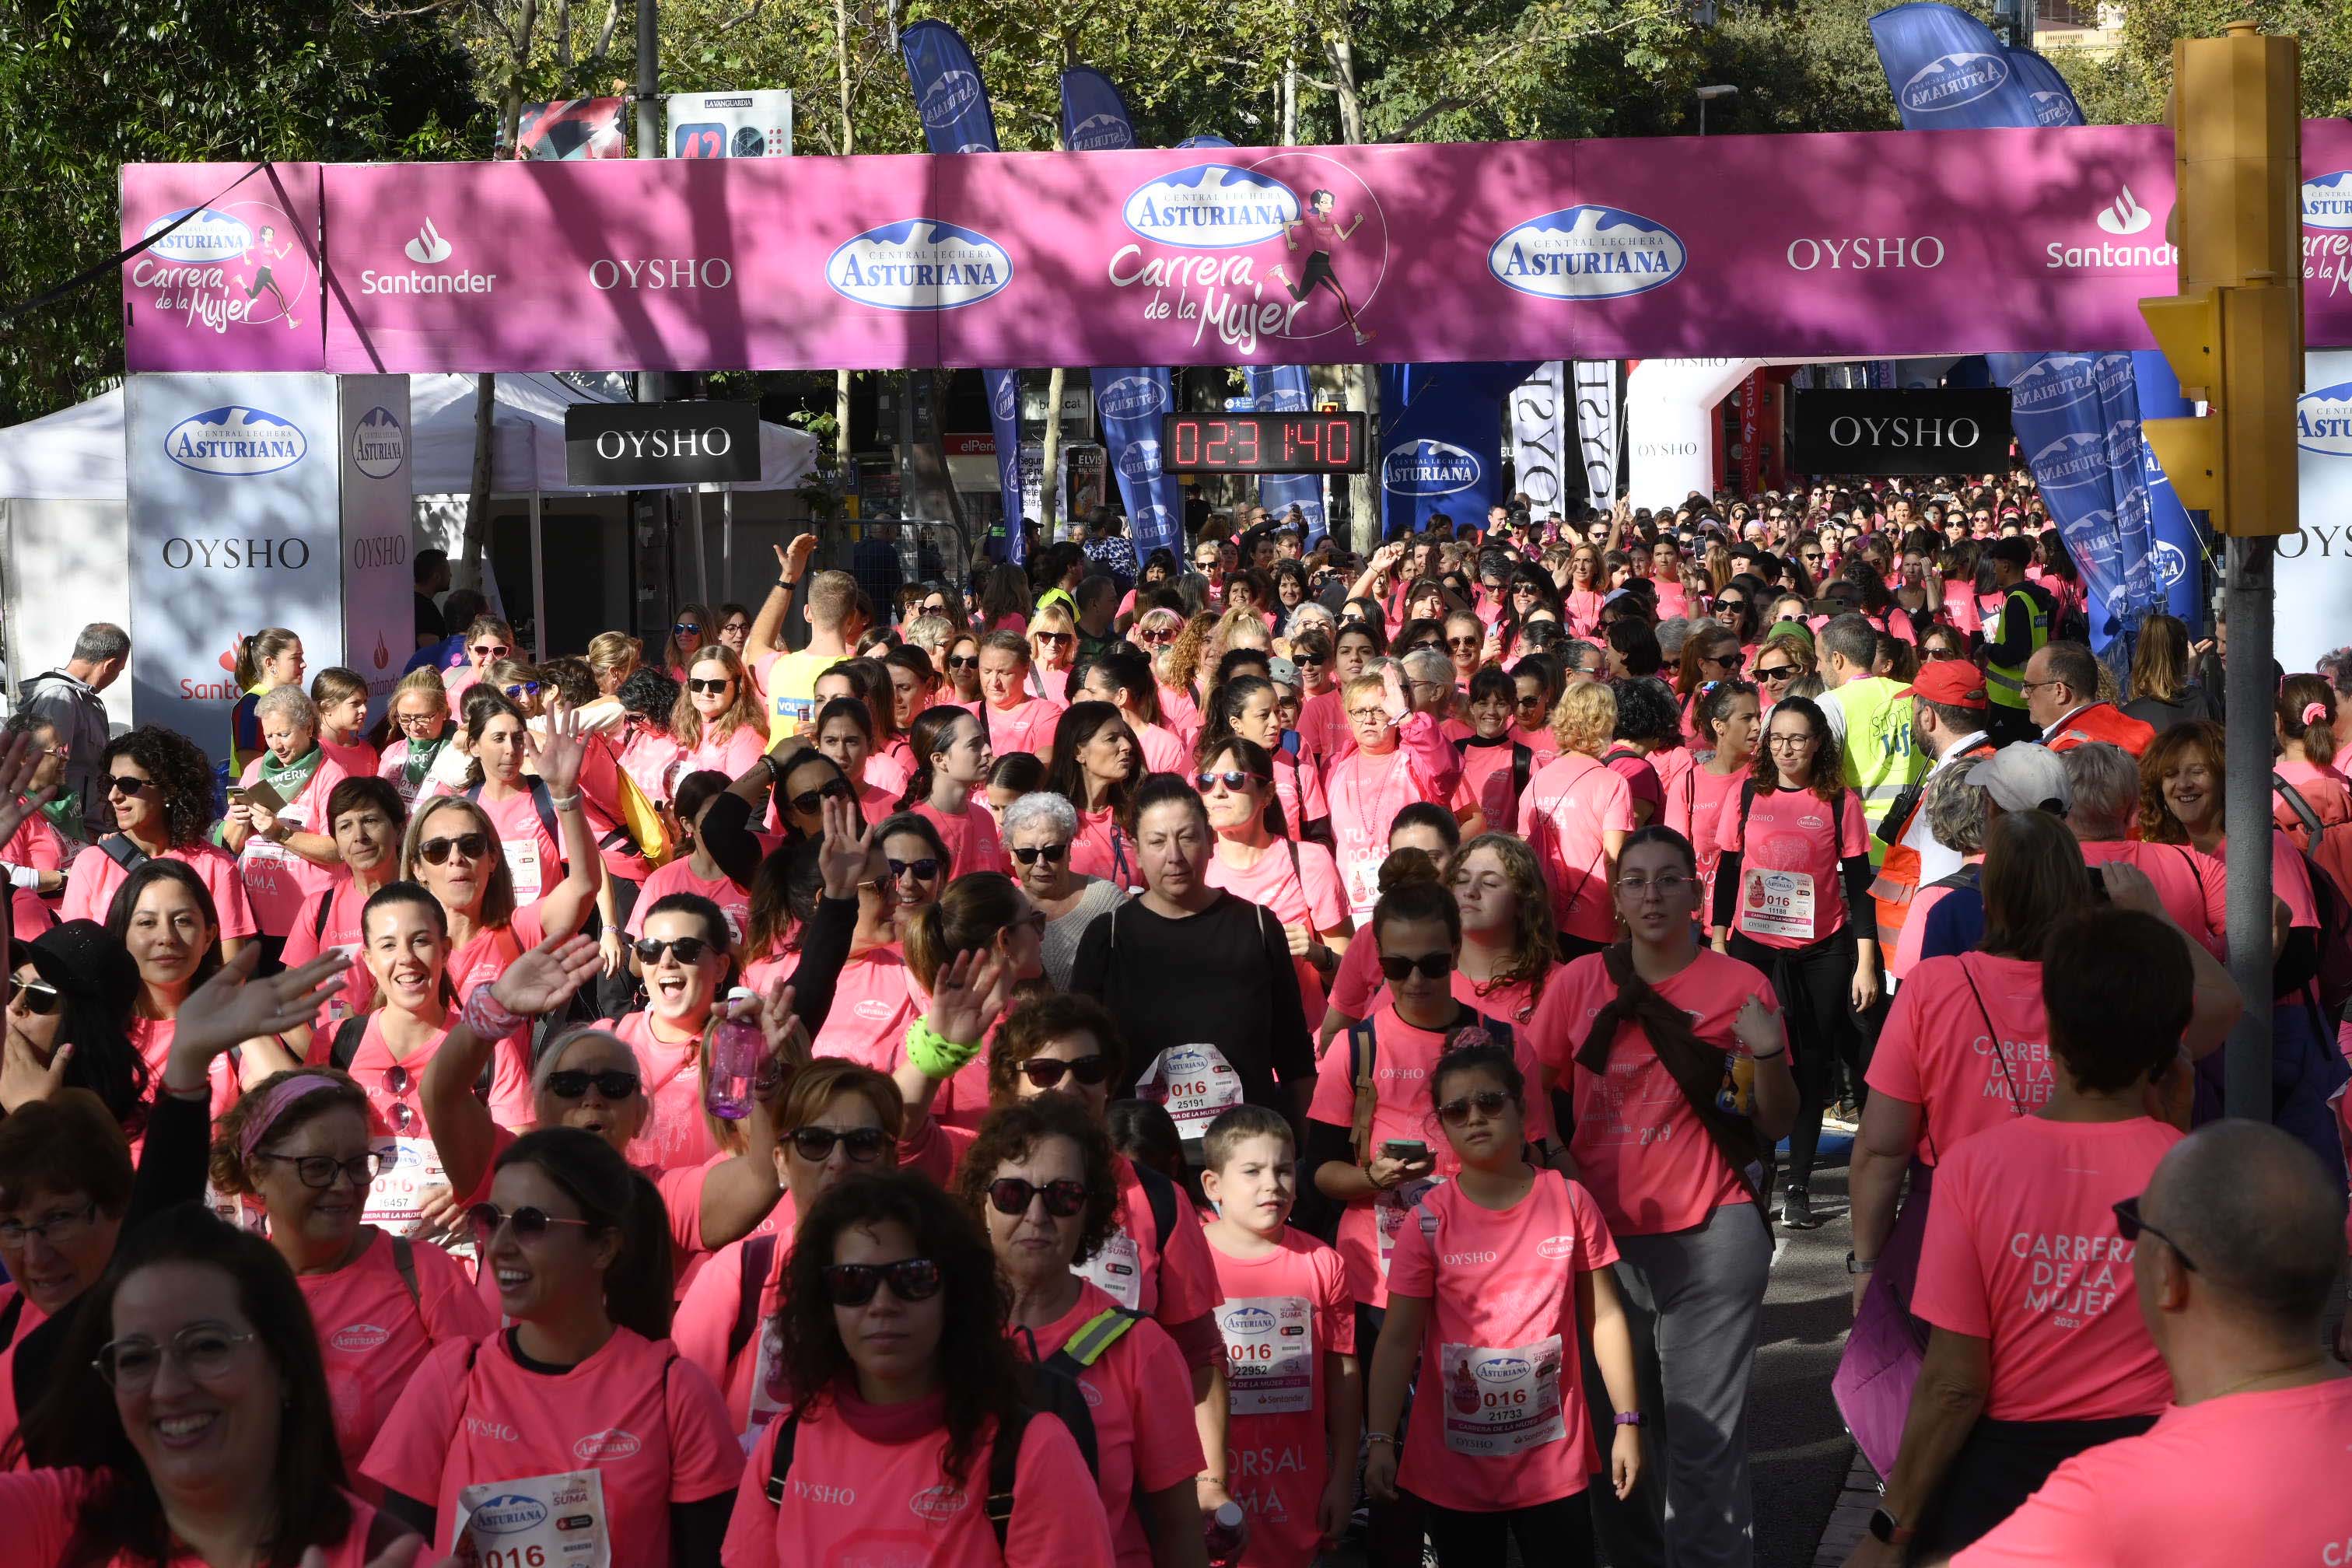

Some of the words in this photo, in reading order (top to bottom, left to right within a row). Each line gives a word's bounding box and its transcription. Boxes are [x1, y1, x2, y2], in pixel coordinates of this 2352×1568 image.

[1164, 193, 1219, 202] CENTRAL
[1137, 195, 1288, 227] ASTURIANA
[1535, 237, 1594, 247] CENTRAL
[1601, 236, 1664, 246] LECHERA
[869, 250, 926, 260] CENTRAL
[1503, 242, 1671, 275] ASTURIANA
[1787, 236, 1944, 271] OYSHO
[840, 254, 998, 286] ASTURIANA
[1108, 244, 1254, 288] Carrera
[133, 259, 225, 288] Carrera
[589, 258, 732, 289] OYSHO
[361, 269, 496, 294] Santander
[156, 289, 172, 309] de
[177, 289, 188, 310] la
[187, 286, 258, 333] Mujer
[1144, 289, 1171, 320] de
[1178, 289, 1196, 319] la
[1192, 282, 1308, 355] Mujer
[1830, 417, 1980, 448] OYSHO
[176, 432, 298, 458] ASTURIANA
[356, 435, 402, 460] ASTURIANA
[597, 427, 731, 459] OYSHO
[1638, 442, 1697, 456] OYSHO
[1078, 454, 1102, 465] ELVIS
[1387, 462, 1474, 482] ASTURIANA
[163, 538, 309, 569] OYSHO
[355, 535, 405, 569] OYSHO
[1747, 813, 1774, 822] OYSHO
[246, 877, 277, 891] UMA
[1767, 880, 1793, 889] ASTURIANA
[1767, 896, 1790, 907] 016
[1166, 1060, 1205, 1073] ASTURIANA
[1380, 1067, 1424, 1079] OYSHO
[1991, 1058, 2017, 1081] DE
[2027, 1062, 2053, 1082] LA
[1172, 1081, 1206, 1097] 016
[1178, 1098, 1204, 1109] 25191
[376, 1179, 413, 1193] 016
[391, 1210, 401, 1219] LA
[1107, 1246, 1133, 1258] SUMA
[1444, 1251, 1497, 1265] OYSHO
[2032, 1262, 2072, 1288] DE
[2079, 1263, 2116, 1289] LA
[1280, 1311, 1302, 1319] SUMA
[1227, 1317, 1273, 1329] ASTURIANA
[1231, 1344, 1272, 1360] 016
[1534, 1353, 1556, 1363] SUMA
[1235, 1364, 1268, 1377] 22952
[1479, 1366, 1528, 1378] ASTURIANA
[1268, 1394, 1304, 1405] Santander
[1483, 1388, 1527, 1407] 016
[1489, 1409, 1523, 1421] 21733
[1524, 1426, 1556, 1442] Santander
[577, 1440, 638, 1454] ASTURIANA
[1456, 1438, 1493, 1450] OYSHO
[553, 1493, 588, 1507] SUMA
[474, 1510, 542, 1530] ASTURIANA
[484, 1544, 544, 1568] 016
